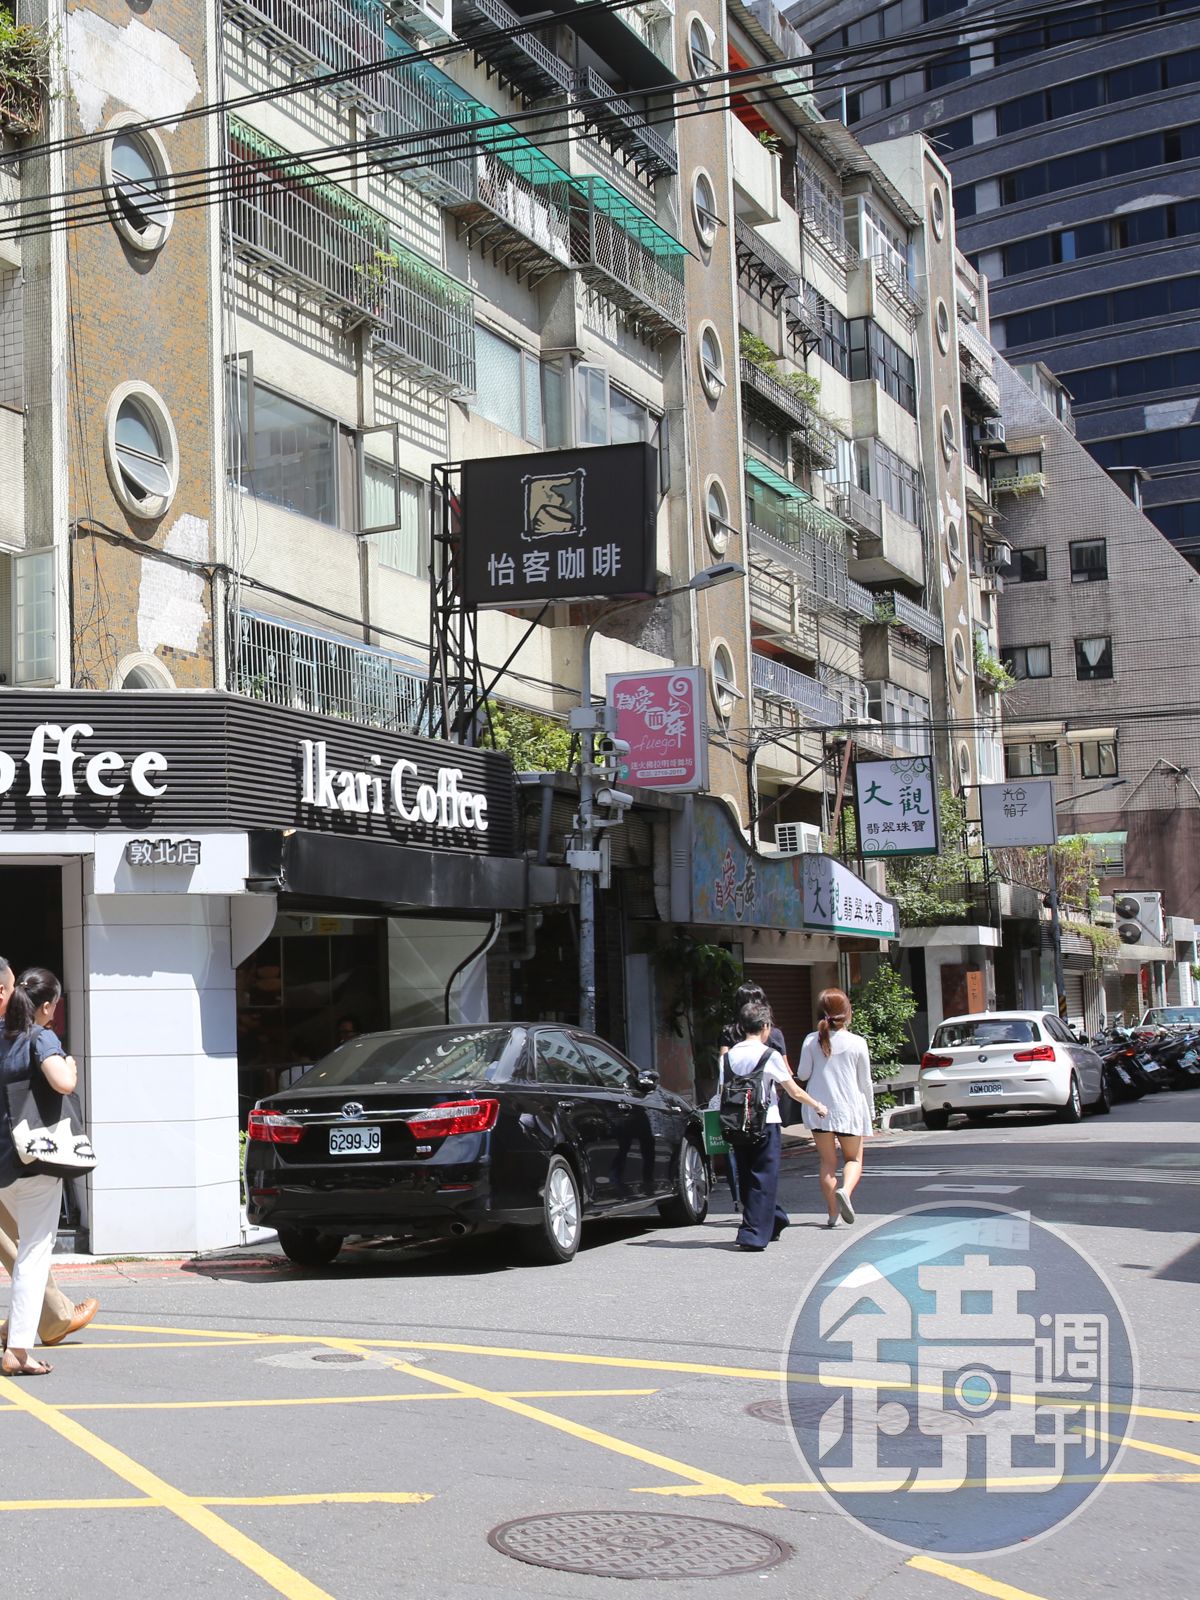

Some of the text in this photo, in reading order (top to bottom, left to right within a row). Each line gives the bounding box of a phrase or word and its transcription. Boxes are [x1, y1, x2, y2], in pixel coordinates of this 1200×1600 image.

[488, 543, 621, 586] 怡客咖啡
[299, 739, 488, 831] Ikari Coffee
[863, 781, 930, 816] 大觀
[867, 820, 926, 834] 翡翠珠寶
[1003, 803, 1028, 818] 箱子
[130, 841, 199, 864] 敦北店
[812, 877, 883, 926] 大觀 翡翠珠寶
